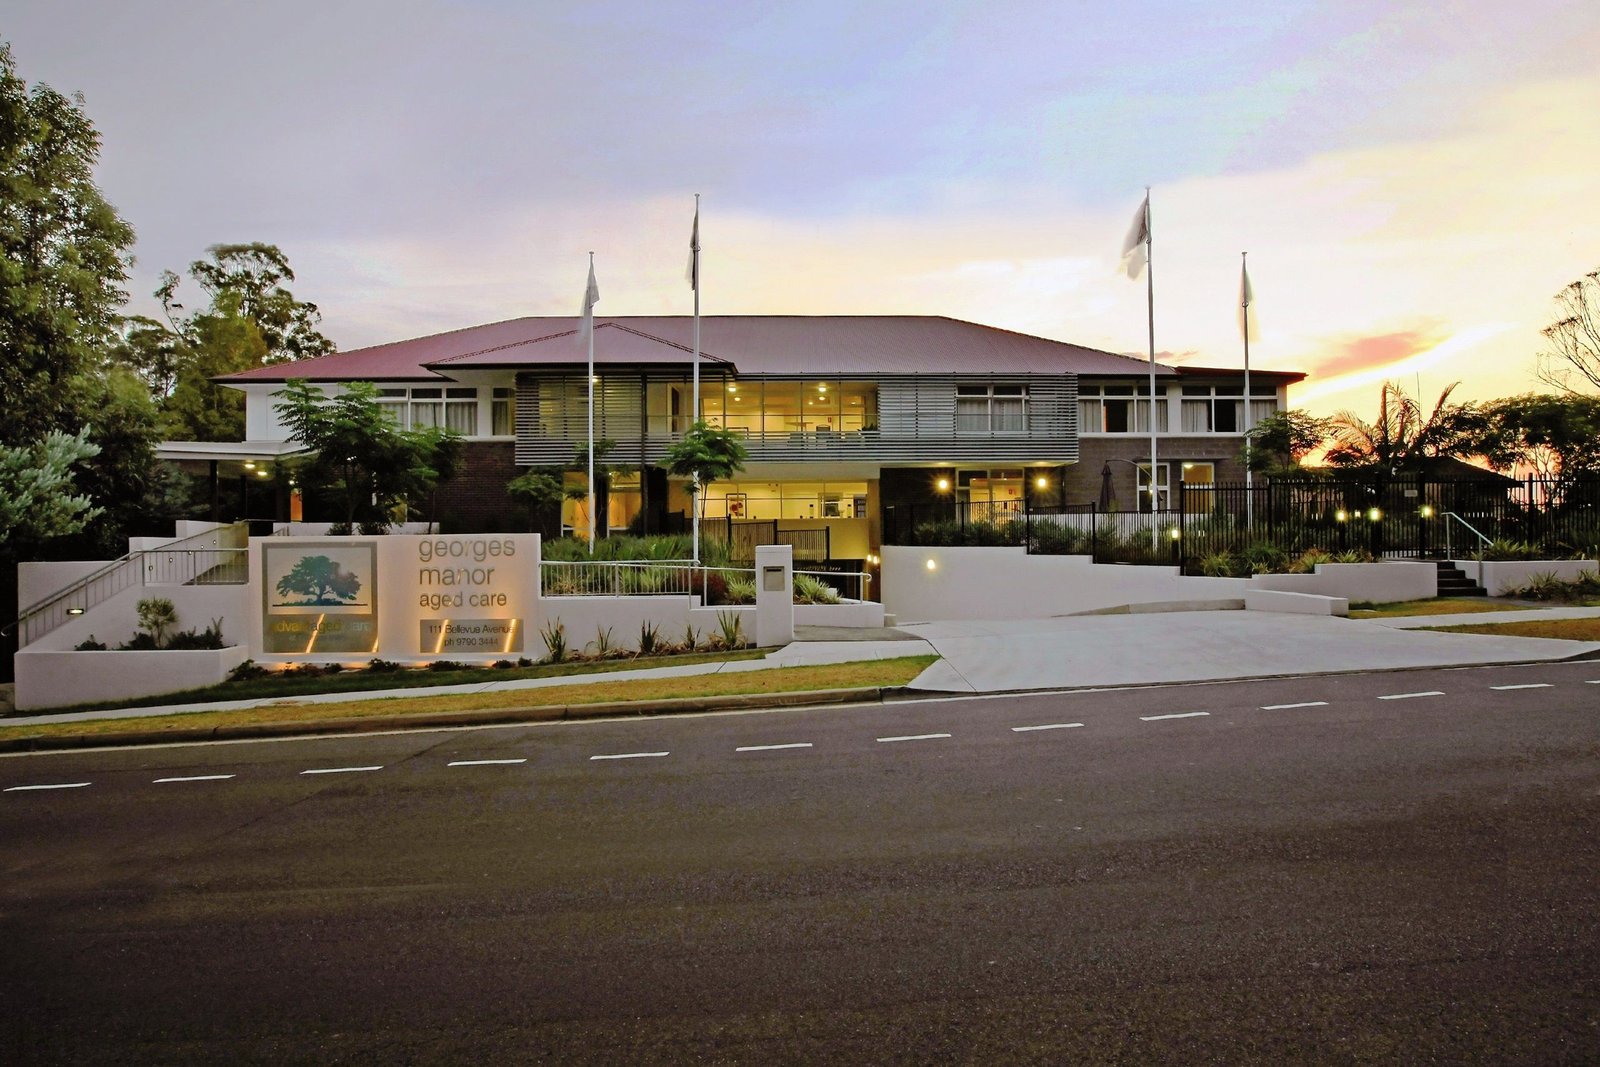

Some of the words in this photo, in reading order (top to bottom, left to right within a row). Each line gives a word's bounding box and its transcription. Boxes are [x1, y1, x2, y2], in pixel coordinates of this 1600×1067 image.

[419, 540, 516, 562] georges
[419, 568, 495, 585] manor
[419, 591, 463, 610] aged
[469, 594, 508, 607] care
[430, 625, 442, 633] 111
[445, 625, 480, 634] Bellevue
[444, 638, 454, 647] ph
[456, 638, 476, 646] 9790
[478, 638, 499, 646] 3444
